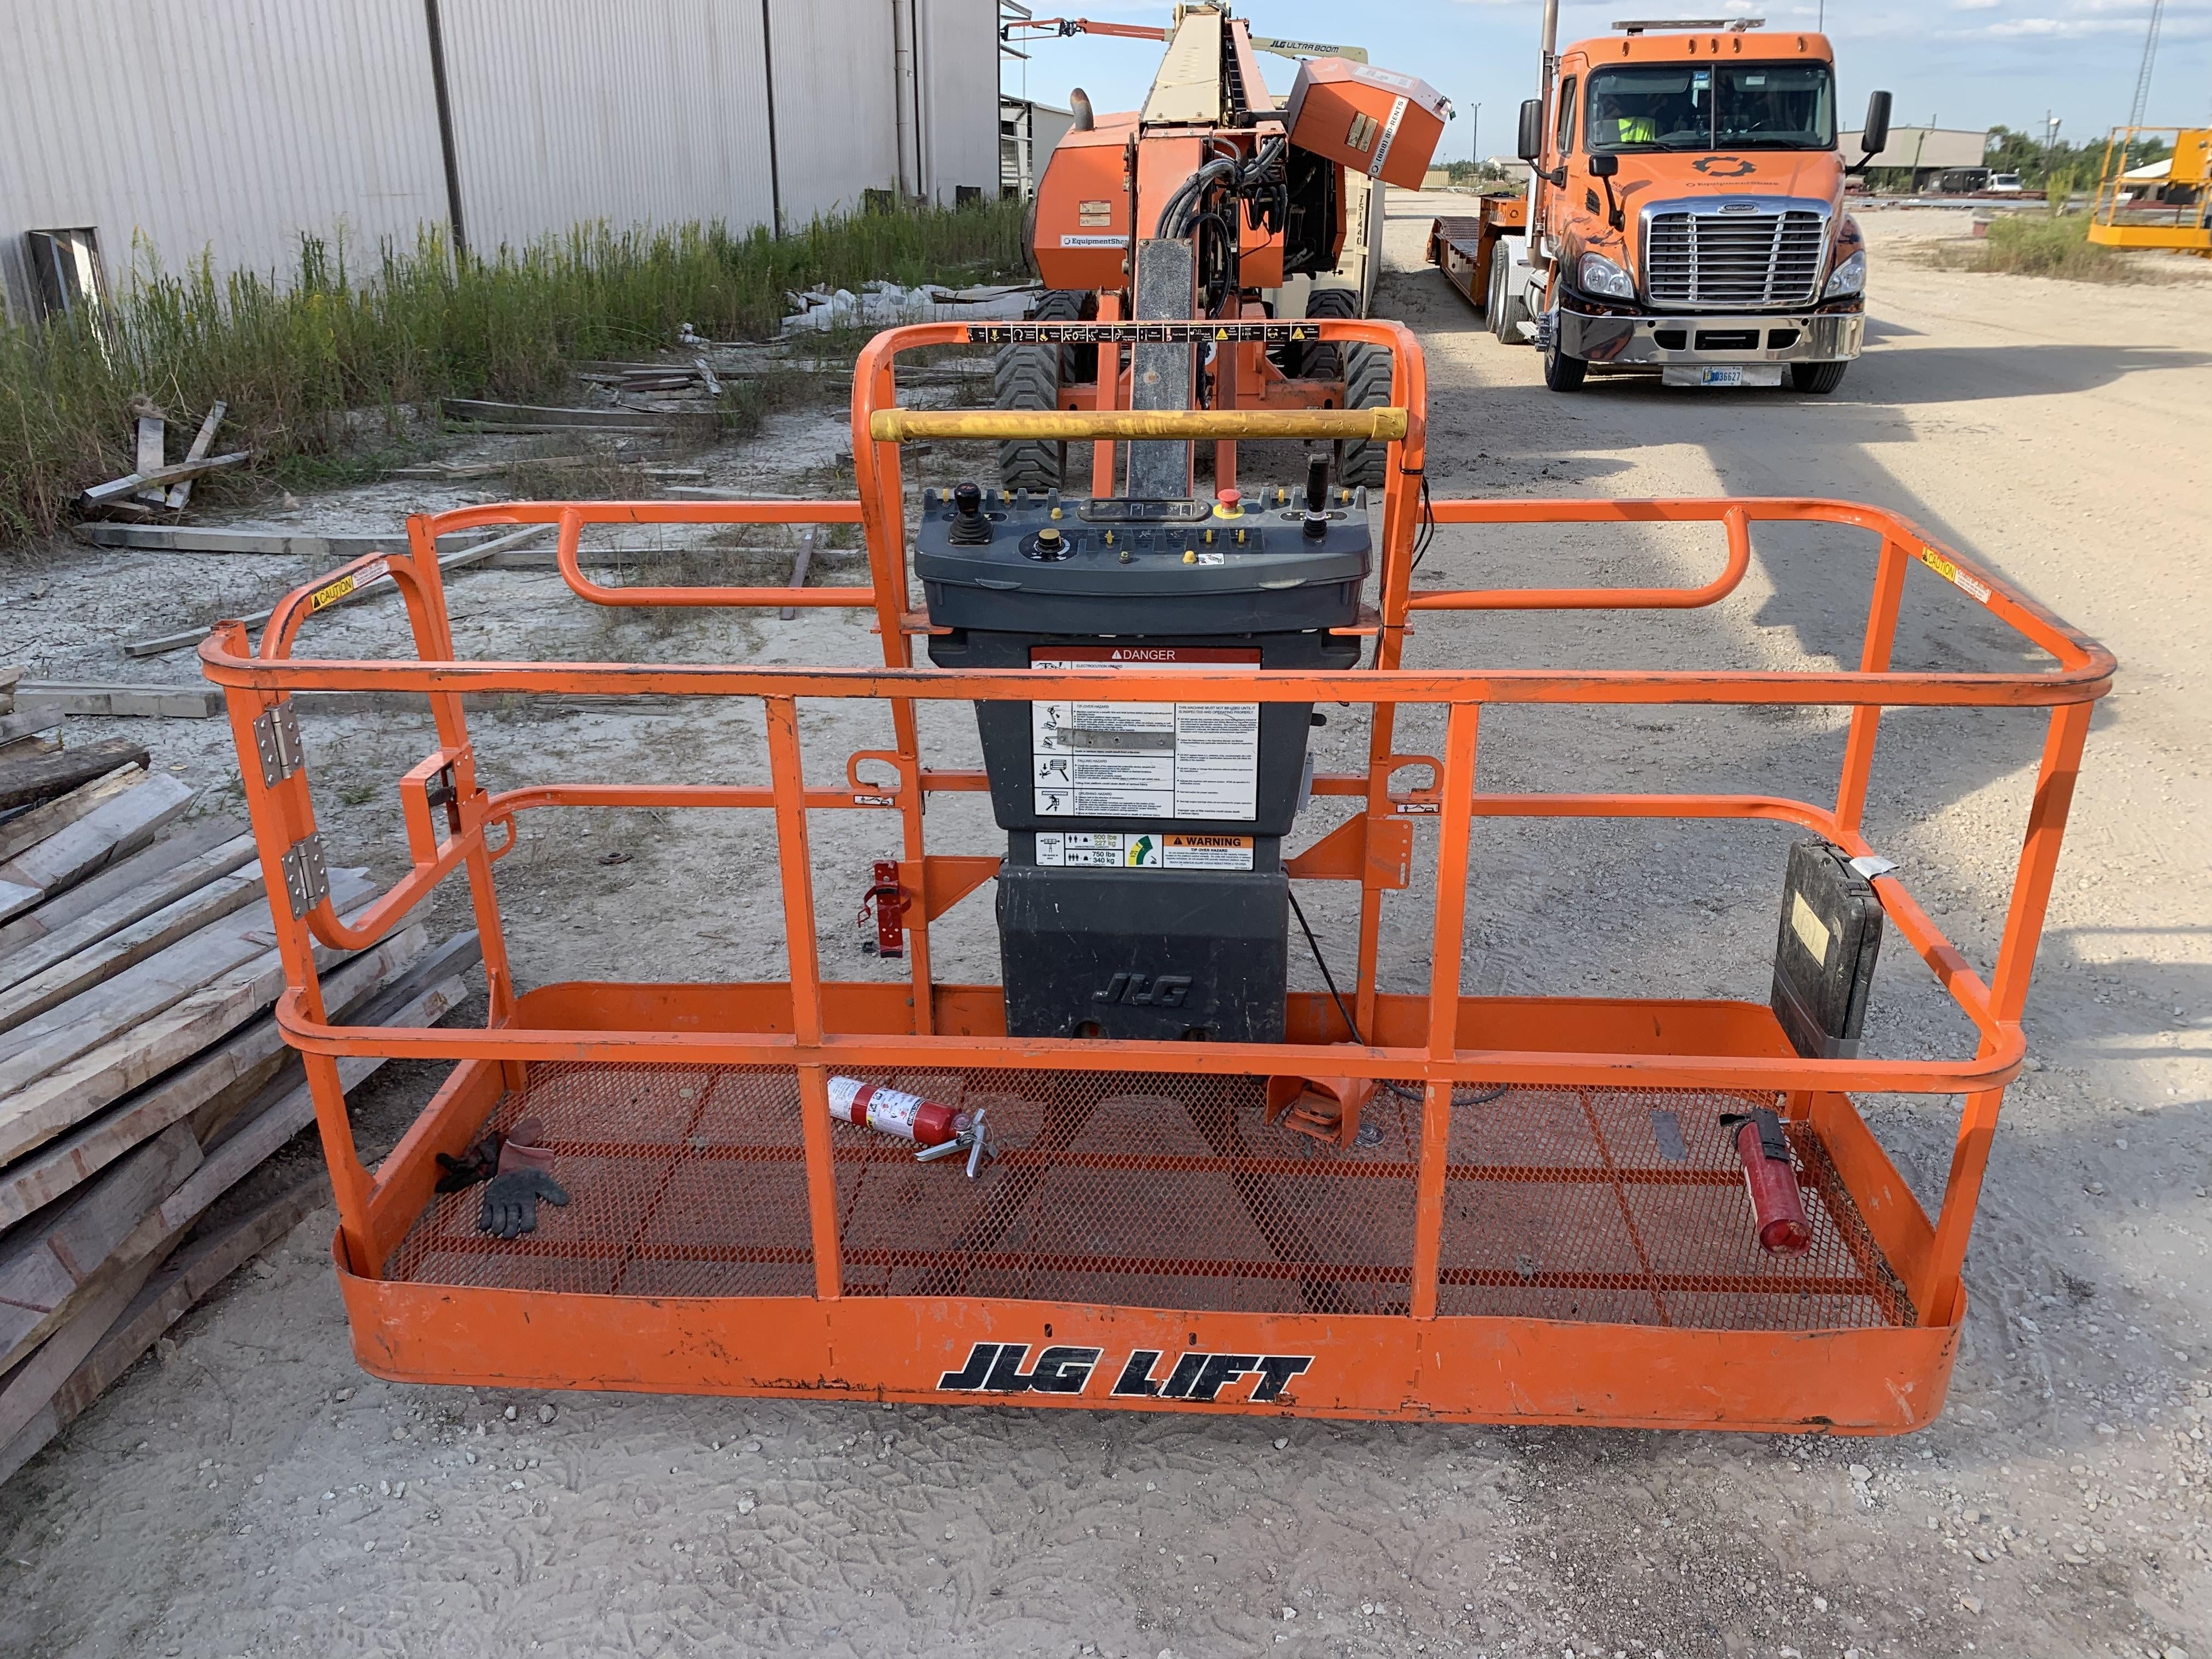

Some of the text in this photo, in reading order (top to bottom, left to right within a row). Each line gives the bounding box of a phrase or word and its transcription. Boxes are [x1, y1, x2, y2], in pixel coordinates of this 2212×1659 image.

[1270, 40, 1339, 53] JLG ULTRA BOOM
[1376, 140, 1389, 162] (888)
[1928, 553, 1955, 578] CAUTION
[320, 578, 351, 603] CAUTION
[1123, 650, 1176, 660] DANGER
[1186, 837, 1241, 847] WARNING
[1091, 973, 1193, 1006] JLG
[936, 1342, 1316, 1402] JLG LIFT
